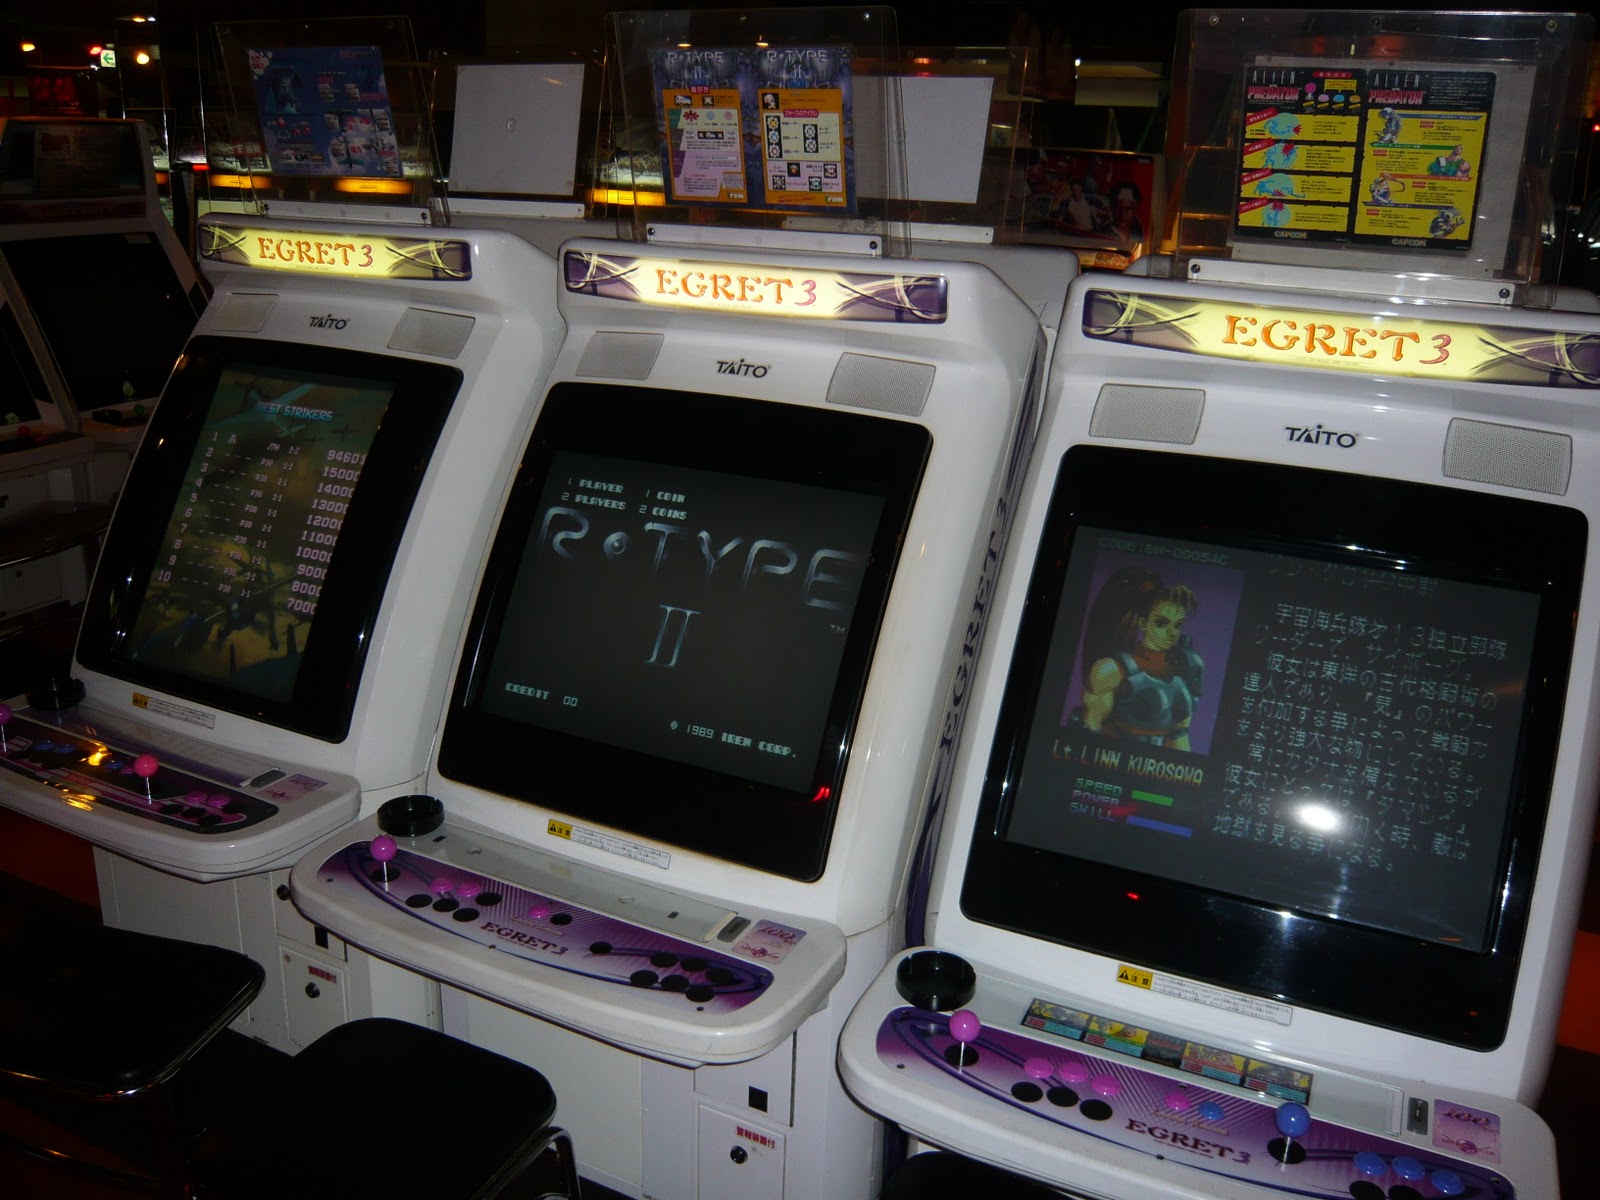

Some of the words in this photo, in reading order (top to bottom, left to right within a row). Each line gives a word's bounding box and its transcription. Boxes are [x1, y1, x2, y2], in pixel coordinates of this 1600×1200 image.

[1252, 70, 1296, 84] ALIEN
[1374, 73, 1420, 88] ALIEN
[1247, 86, 1300, 100] PREDATOR
[1368, 89, 1424, 105] PREDATOR
[1274, 230, 1308, 239] CAPCOM
[1392, 239, 1426, 247] CAPCOM
[257, 237, 355, 266] EGRET
[358, 244, 373, 267] 3
[655, 269, 794, 304] EGRET
[795, 279, 817, 307] 3
[1221, 314, 1420, 362] EGRET
[1419, 333, 1452, 365] 3
[257, 401, 281, 415] BEST
[284, 405, 333, 422] STRIKERS
[212, 432, 219, 442] 1
[229, 434, 237, 444] A
[206, 448, 214, 458] 2
[201, 463, 209, 473] 3
[195, 478, 202, 488] 4
[190, 493, 198, 503] 5
[578, 479, 624, 494] PLAYER
[656, 490, 686, 503] COIN
[185, 508, 192, 518] 6
[561, 491, 570, 501] 2
[574, 494, 627, 511] PLAYERS
[639, 505, 647, 514] 2
[651, 506, 688, 521] COINS
[181, 523, 188, 533] 7
[174, 539, 182, 550] 8
[169, 555, 177, 566] 9
[158, 570, 172, 582] 10
[940, 530, 997, 755] EGRET
[997, 496, 1008, 534] 3
[505, 682, 550, 700] CREDIT
[563, 695, 578, 707] 00
[686, 724, 714, 739] 1989
[721, 732, 752, 748] IREM
[1127, 755, 1204, 787] KUROSAWA
[1075, 778, 1122, 796] SPEED
[1069, 802, 1118, 822] SKILL
[480, 921, 556, 950] EGRET
[551, 946, 568, 956] 3
[1131, 975, 1149, 986] 注意
[1125, 1118, 1234, 1158] EGRET
[1233, 1151, 1252, 1165] 3
